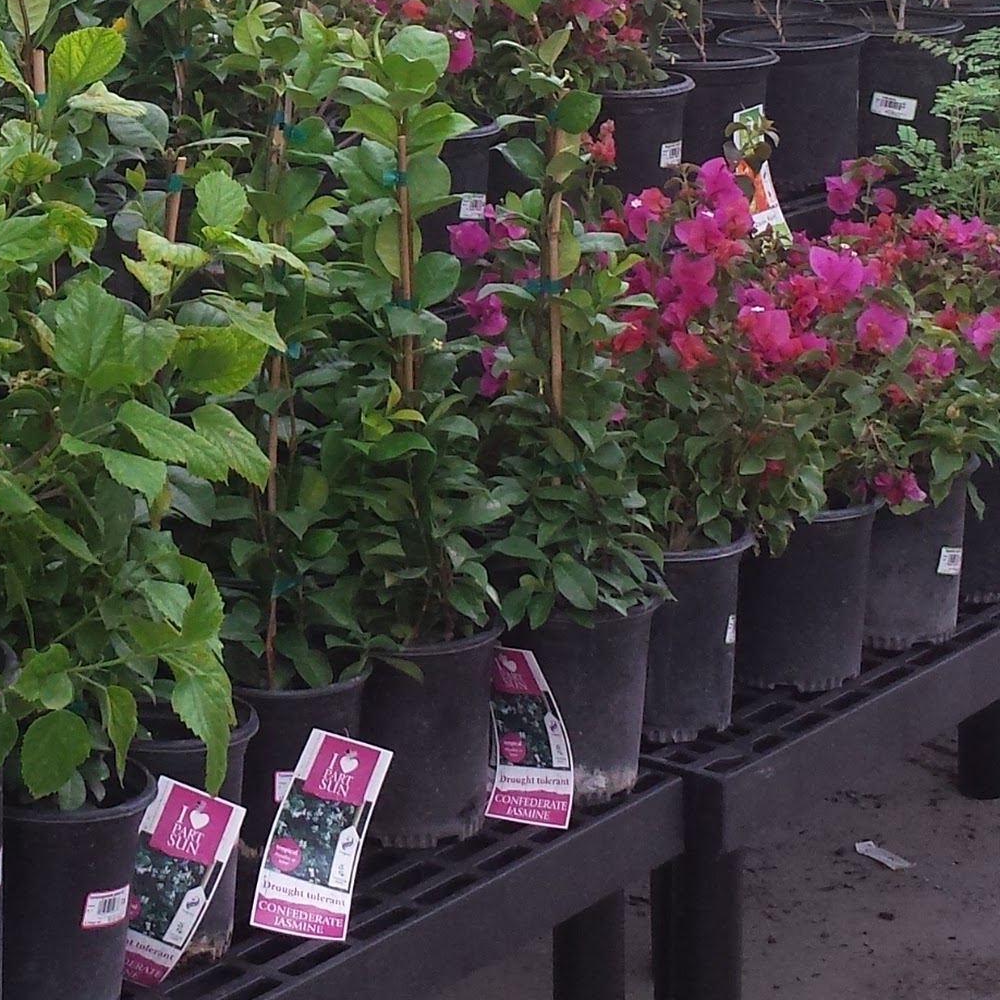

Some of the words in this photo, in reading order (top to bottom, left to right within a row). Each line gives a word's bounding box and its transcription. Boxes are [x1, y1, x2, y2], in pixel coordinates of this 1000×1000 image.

[328, 752, 340, 771] I
[322, 767, 354, 787] PART
[500, 775, 535, 786] Drought
[536, 776, 569, 786] tolerant
[318, 778, 351, 797] SUN
[494, 793, 568, 811] CONFEDERATE
[176, 804, 189, 824] I
[505, 805, 551, 820] JASMINE
[171, 822, 203, 844] PART
[166, 834, 201, 856] SUN
[263, 880, 304, 898] Drought
[306, 892, 346, 907] tolerant
[258, 900, 344, 928] CONFEDERATE
[273, 915, 324, 934] JASMINE
[135, 940, 175, 960] tolerant
